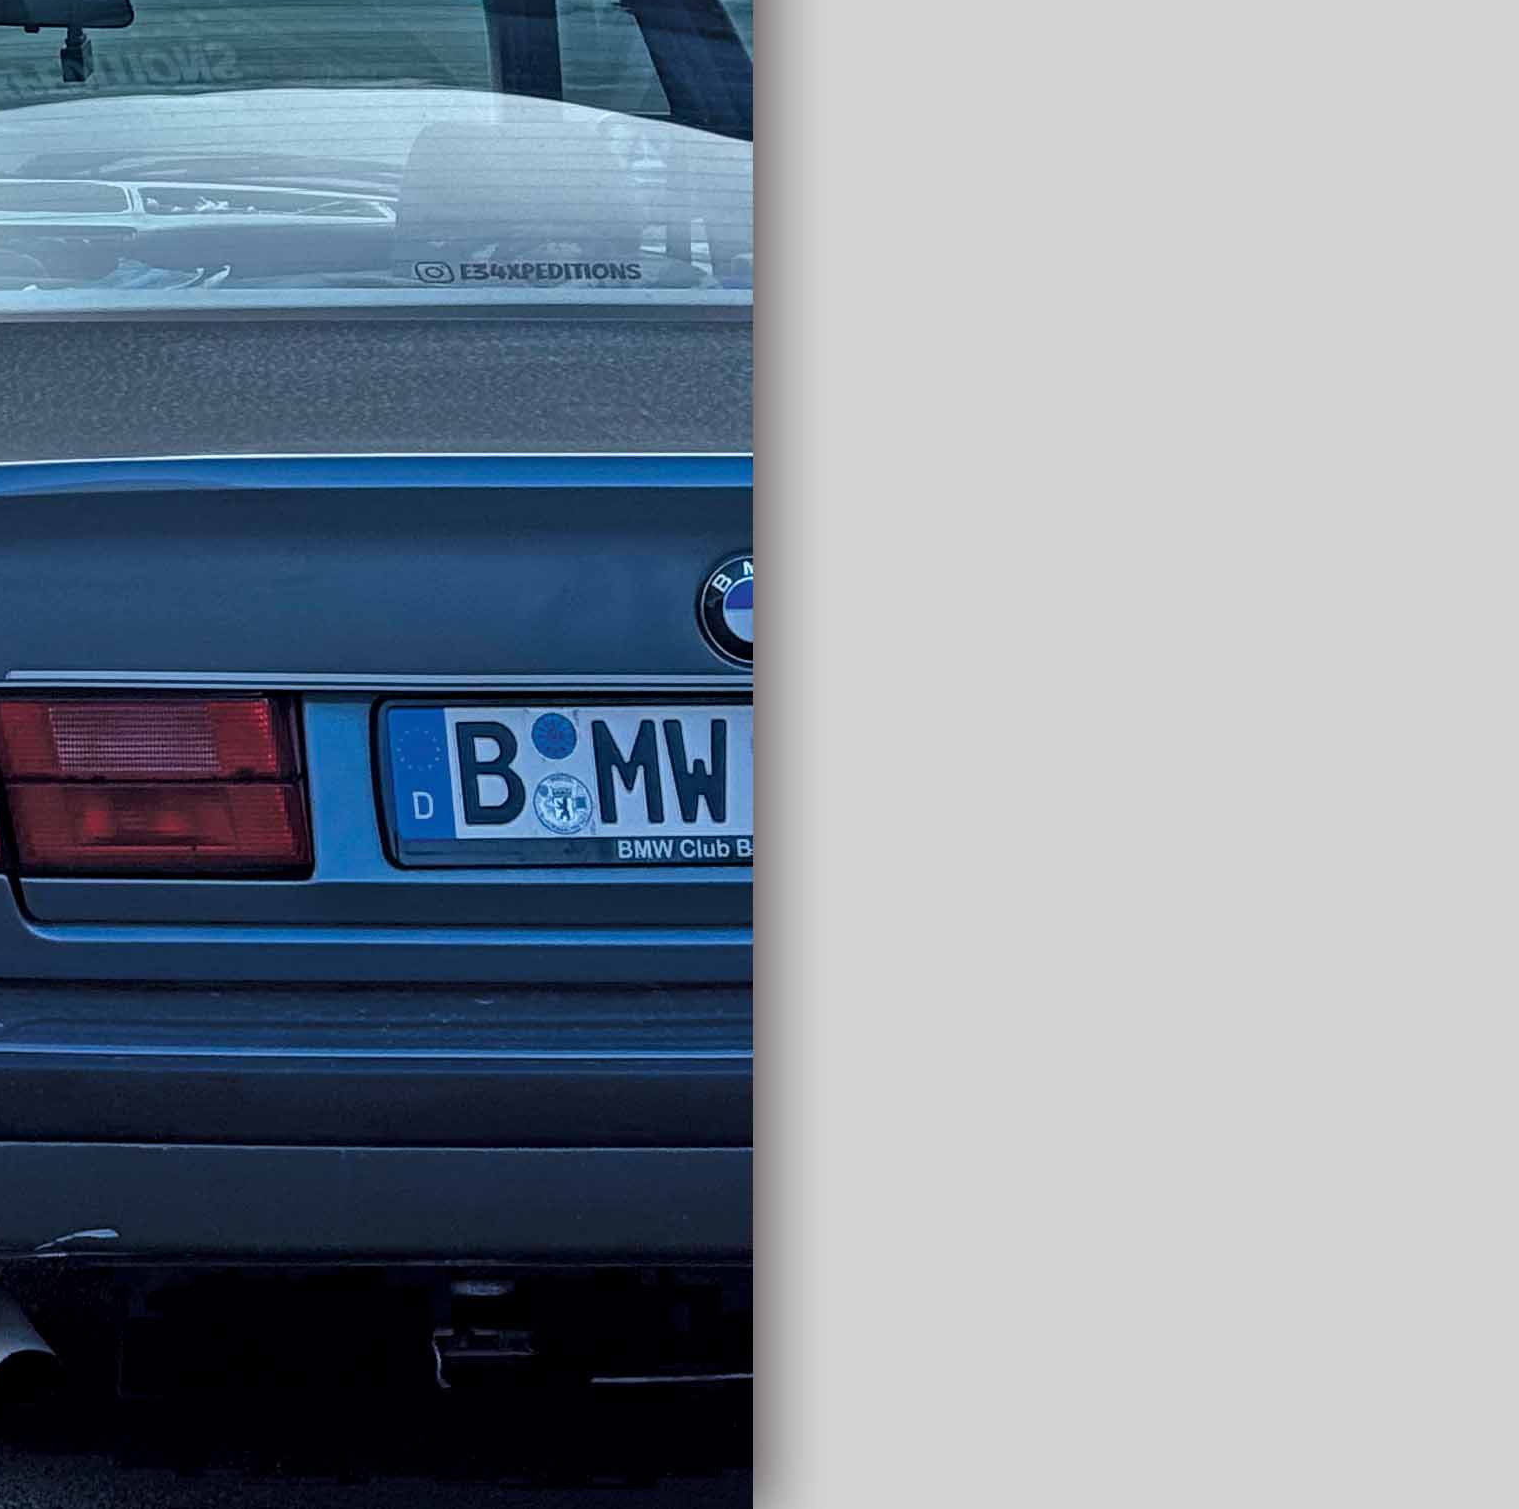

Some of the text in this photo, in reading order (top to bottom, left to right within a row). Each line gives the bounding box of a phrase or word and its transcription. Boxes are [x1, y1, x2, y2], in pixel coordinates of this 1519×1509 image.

[459, 261, 643, 281] E34XPEDITIONS
[455, 719, 527, 826] B
[591, 719, 728, 824] MW
[413, 791, 434, 820] D
[617, 838, 753, 859] BMW Club B
